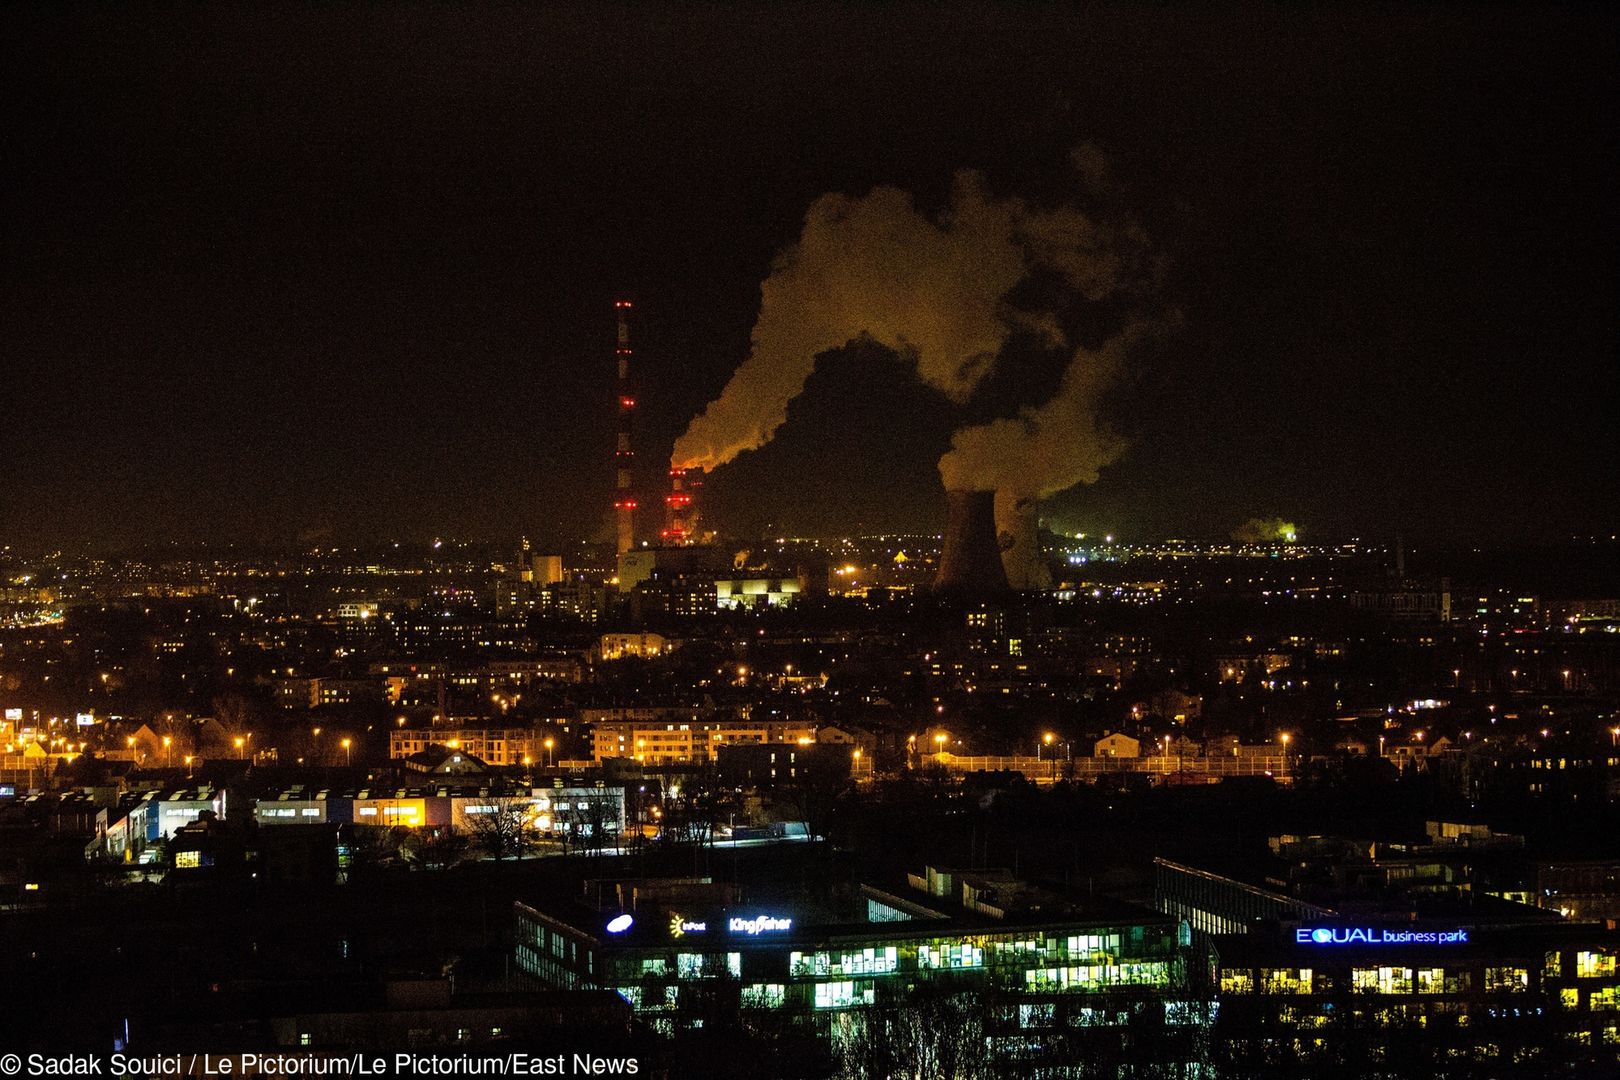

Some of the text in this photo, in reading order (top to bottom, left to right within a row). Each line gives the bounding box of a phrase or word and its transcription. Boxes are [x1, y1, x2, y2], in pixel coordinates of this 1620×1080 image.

[1296, 928, 1467, 944] EQUAL business park
